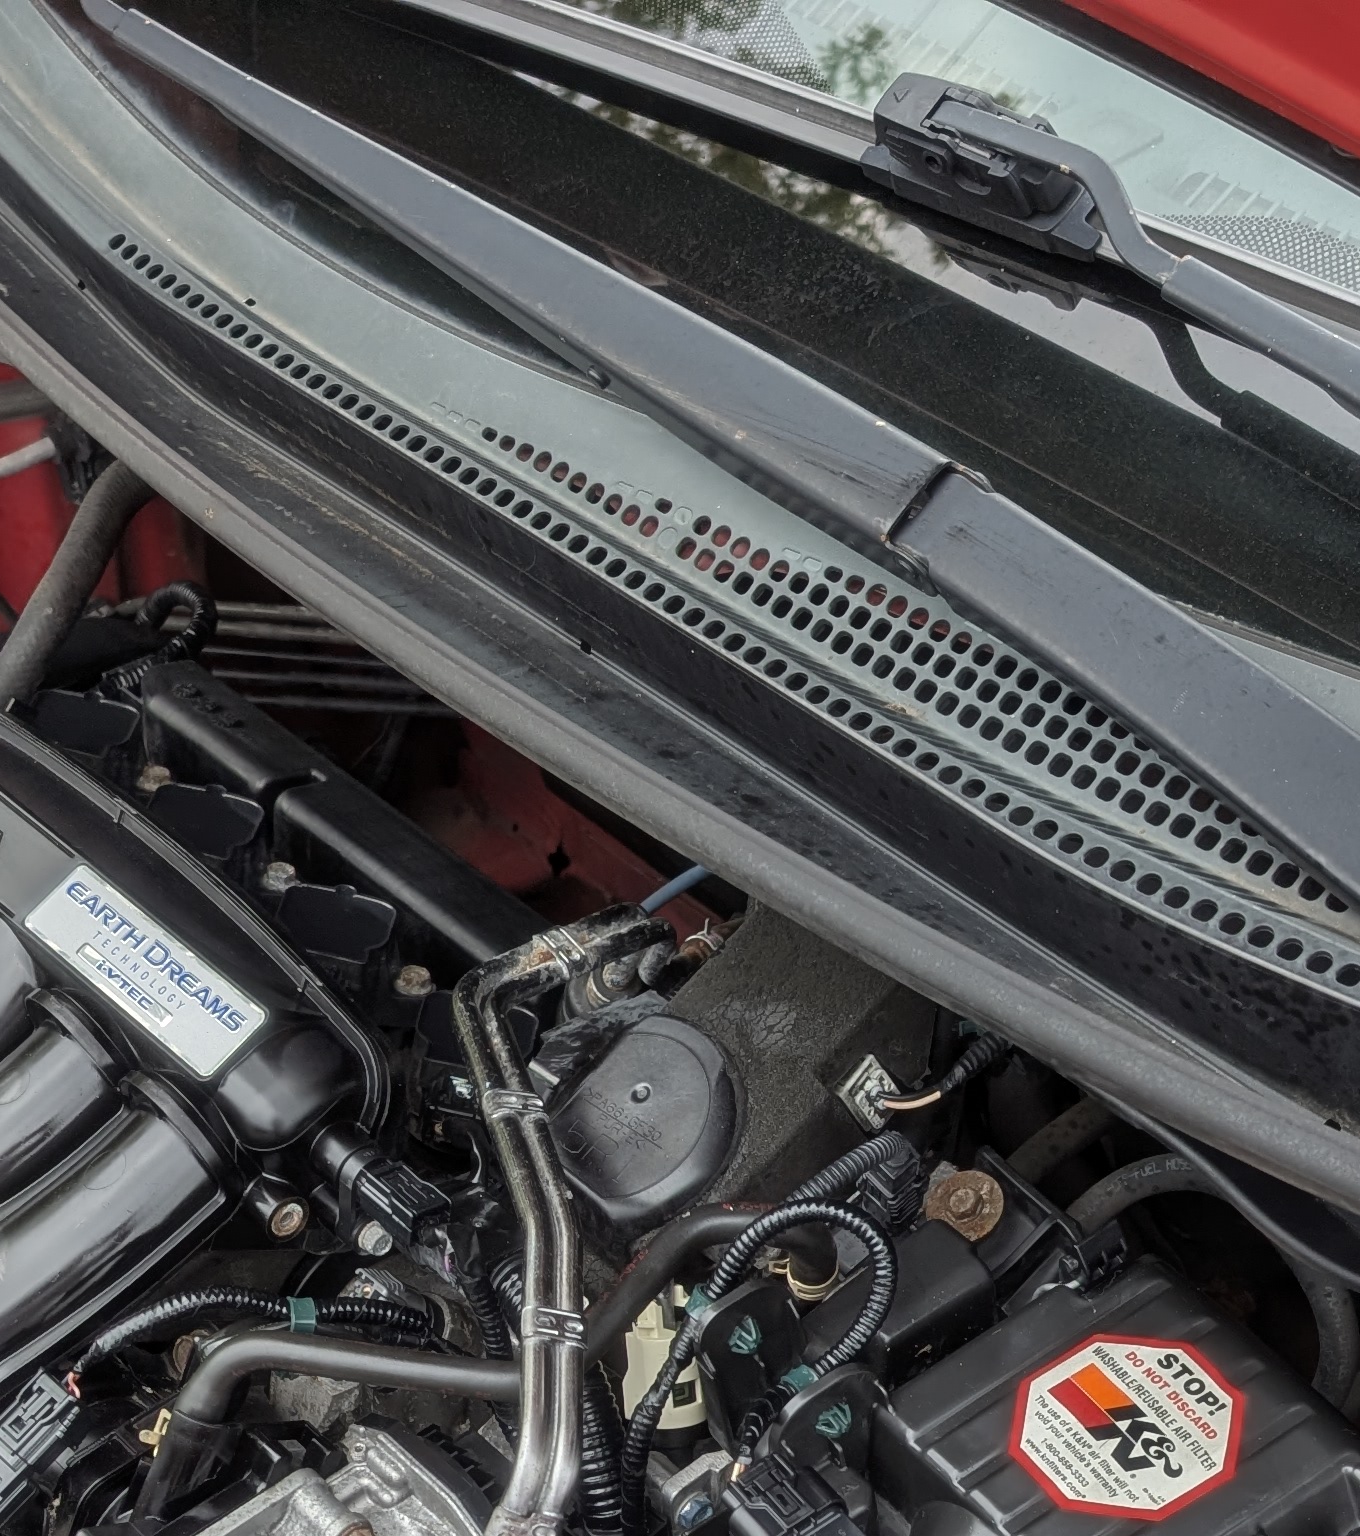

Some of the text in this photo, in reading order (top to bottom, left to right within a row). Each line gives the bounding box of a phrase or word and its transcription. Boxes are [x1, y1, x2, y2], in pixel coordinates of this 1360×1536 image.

[63, 878, 248, 1034] EARTH DREAMS
[91, 930, 185, 1011] TECHNOLOGY
[1091, 1345, 1217, 1472] WASHABLE/REUSABLE AIR FILTER
[1124, 1350, 1219, 1440] DO NOT DISCARD
[1155, 1352, 1227, 1417] STOP!
[1034, 1394, 1049, 1409] The
[1046, 1407, 1061, 1421] use
[1058, 1417, 1070, 1429] of
[1088, 1448, 1101, 1461] air
[1096, 1458, 1116, 1478] filter
[1111, 1474, 1128, 1491] will
[1123, 1487, 1139, 1503] not
[1034, 1409, 1050, 1426] void
[1046, 1425, 1063, 1441] your
[1088, 1467, 1119, 1499] warranty
